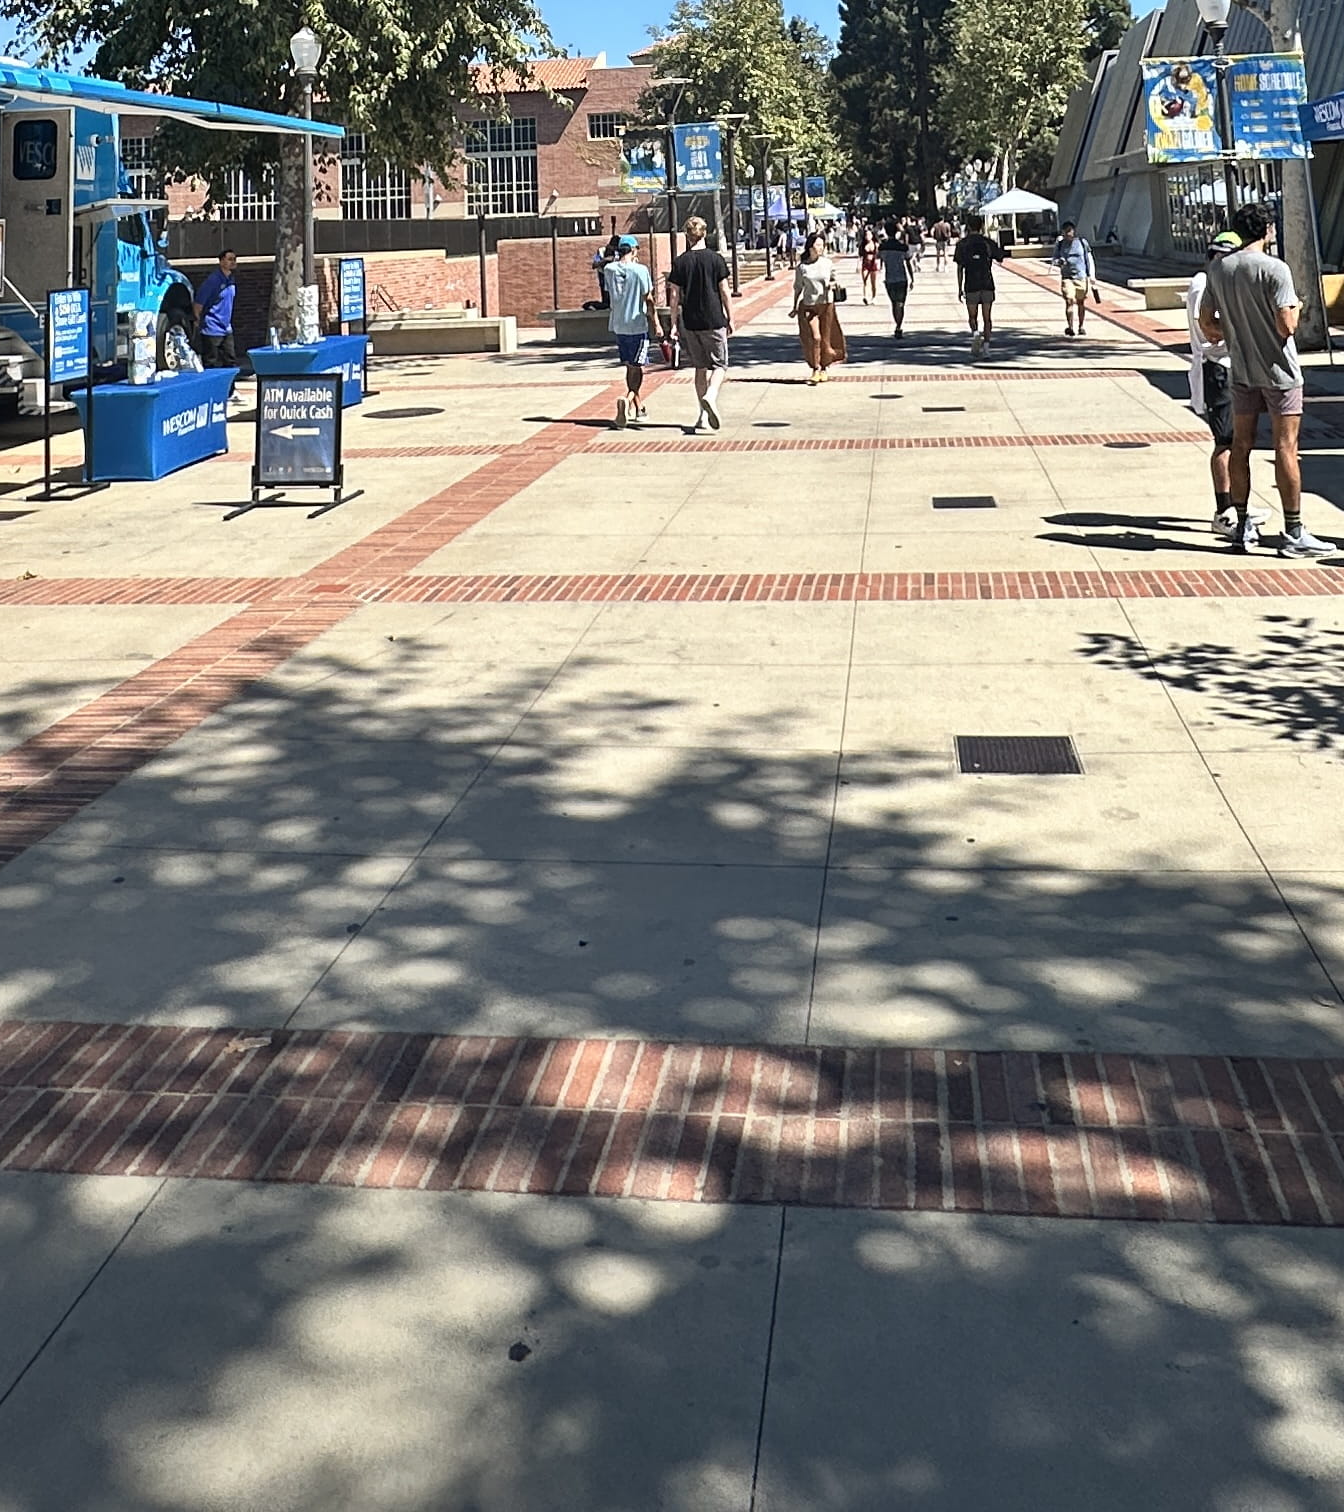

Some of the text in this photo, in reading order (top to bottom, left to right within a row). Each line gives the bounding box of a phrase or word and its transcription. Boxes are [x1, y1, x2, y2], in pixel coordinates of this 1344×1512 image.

[1312, 99, 1340, 123] WESCOM
[264, 387, 333, 403] ATM Available
[162, 407, 197, 436] WESCOM
[264, 404, 333, 421] for Quick Cash
